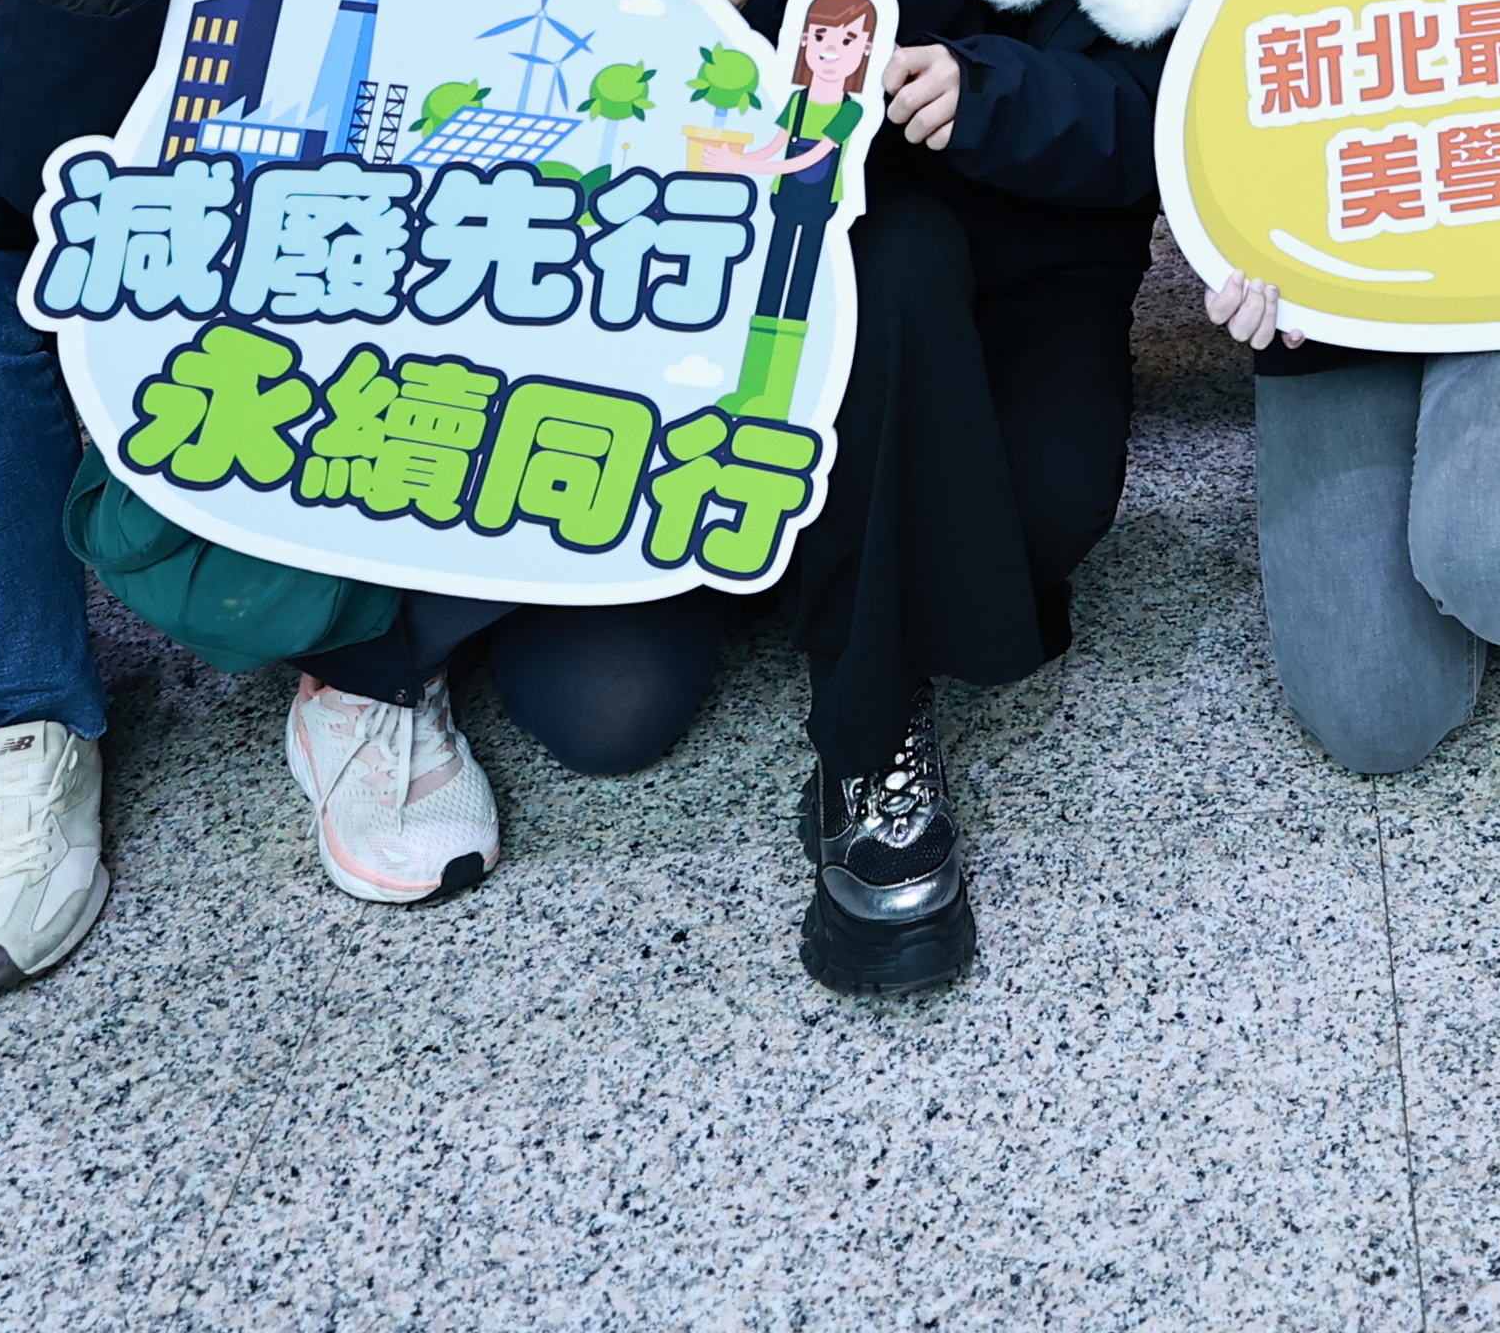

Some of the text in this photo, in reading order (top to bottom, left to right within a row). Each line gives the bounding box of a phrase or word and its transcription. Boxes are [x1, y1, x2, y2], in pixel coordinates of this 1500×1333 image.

[41, 155, 753, 329] 減廢先行
[123, 321, 819, 578] 永續同行
